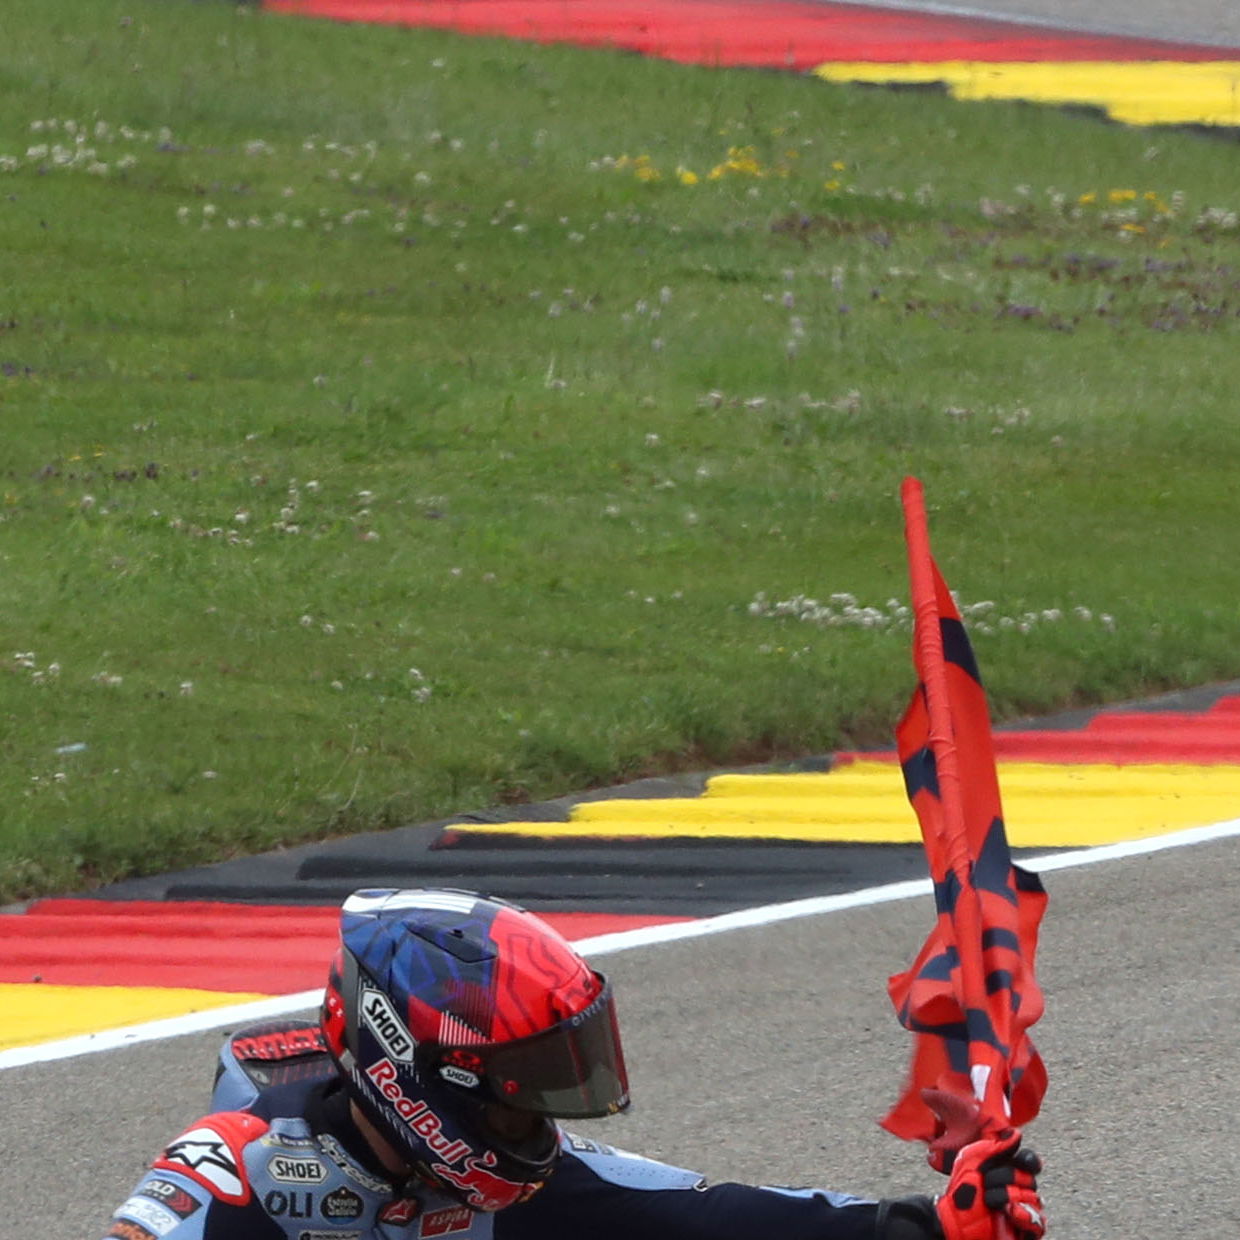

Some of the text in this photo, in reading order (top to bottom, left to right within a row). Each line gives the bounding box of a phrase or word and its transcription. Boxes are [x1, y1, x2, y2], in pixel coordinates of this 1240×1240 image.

[363, 996, 412, 1057] SHOEI
[446, 1069, 474, 1087] SHOEI
[275, 1160, 322, 1180] SHOEI
